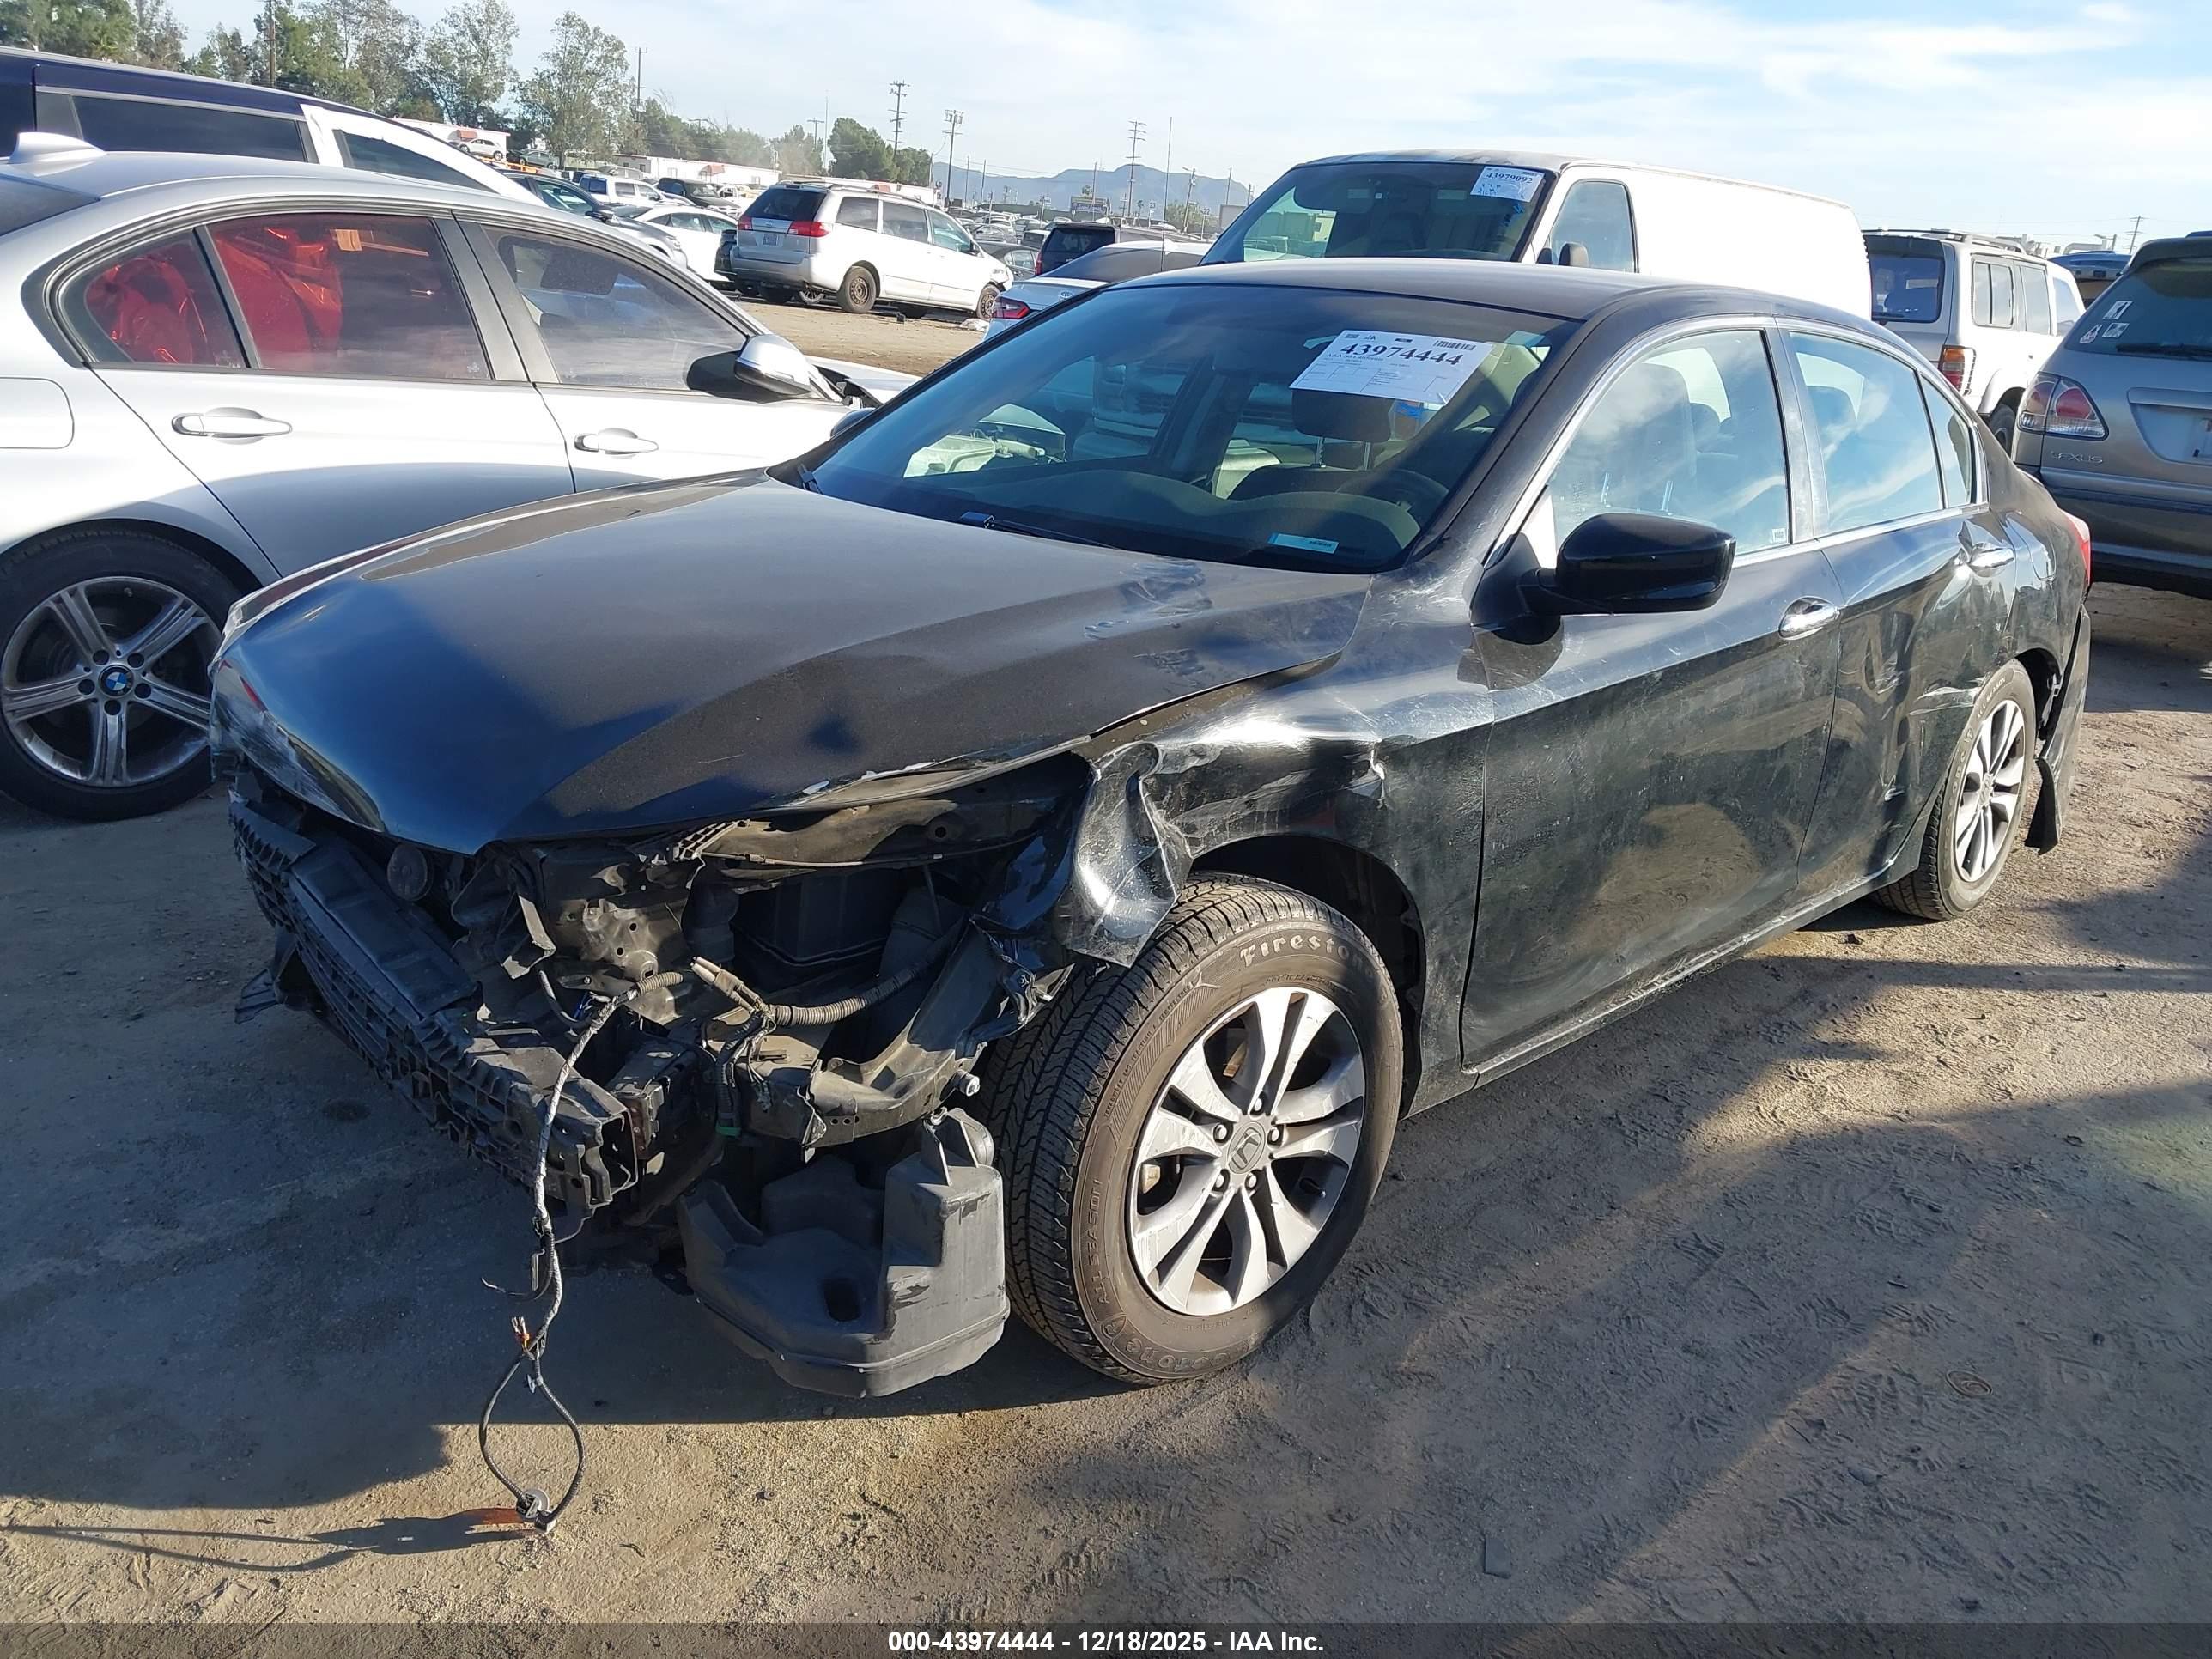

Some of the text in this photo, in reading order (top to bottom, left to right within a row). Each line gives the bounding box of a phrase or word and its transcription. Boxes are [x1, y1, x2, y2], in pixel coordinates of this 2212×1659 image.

[1486, 173, 1533, 184] 43979092
[1340, 343, 1463, 365] 43974444
[2051, 451, 2103, 464] LEXUS
[1087, 1179, 1110, 1304] ALL SEASON
